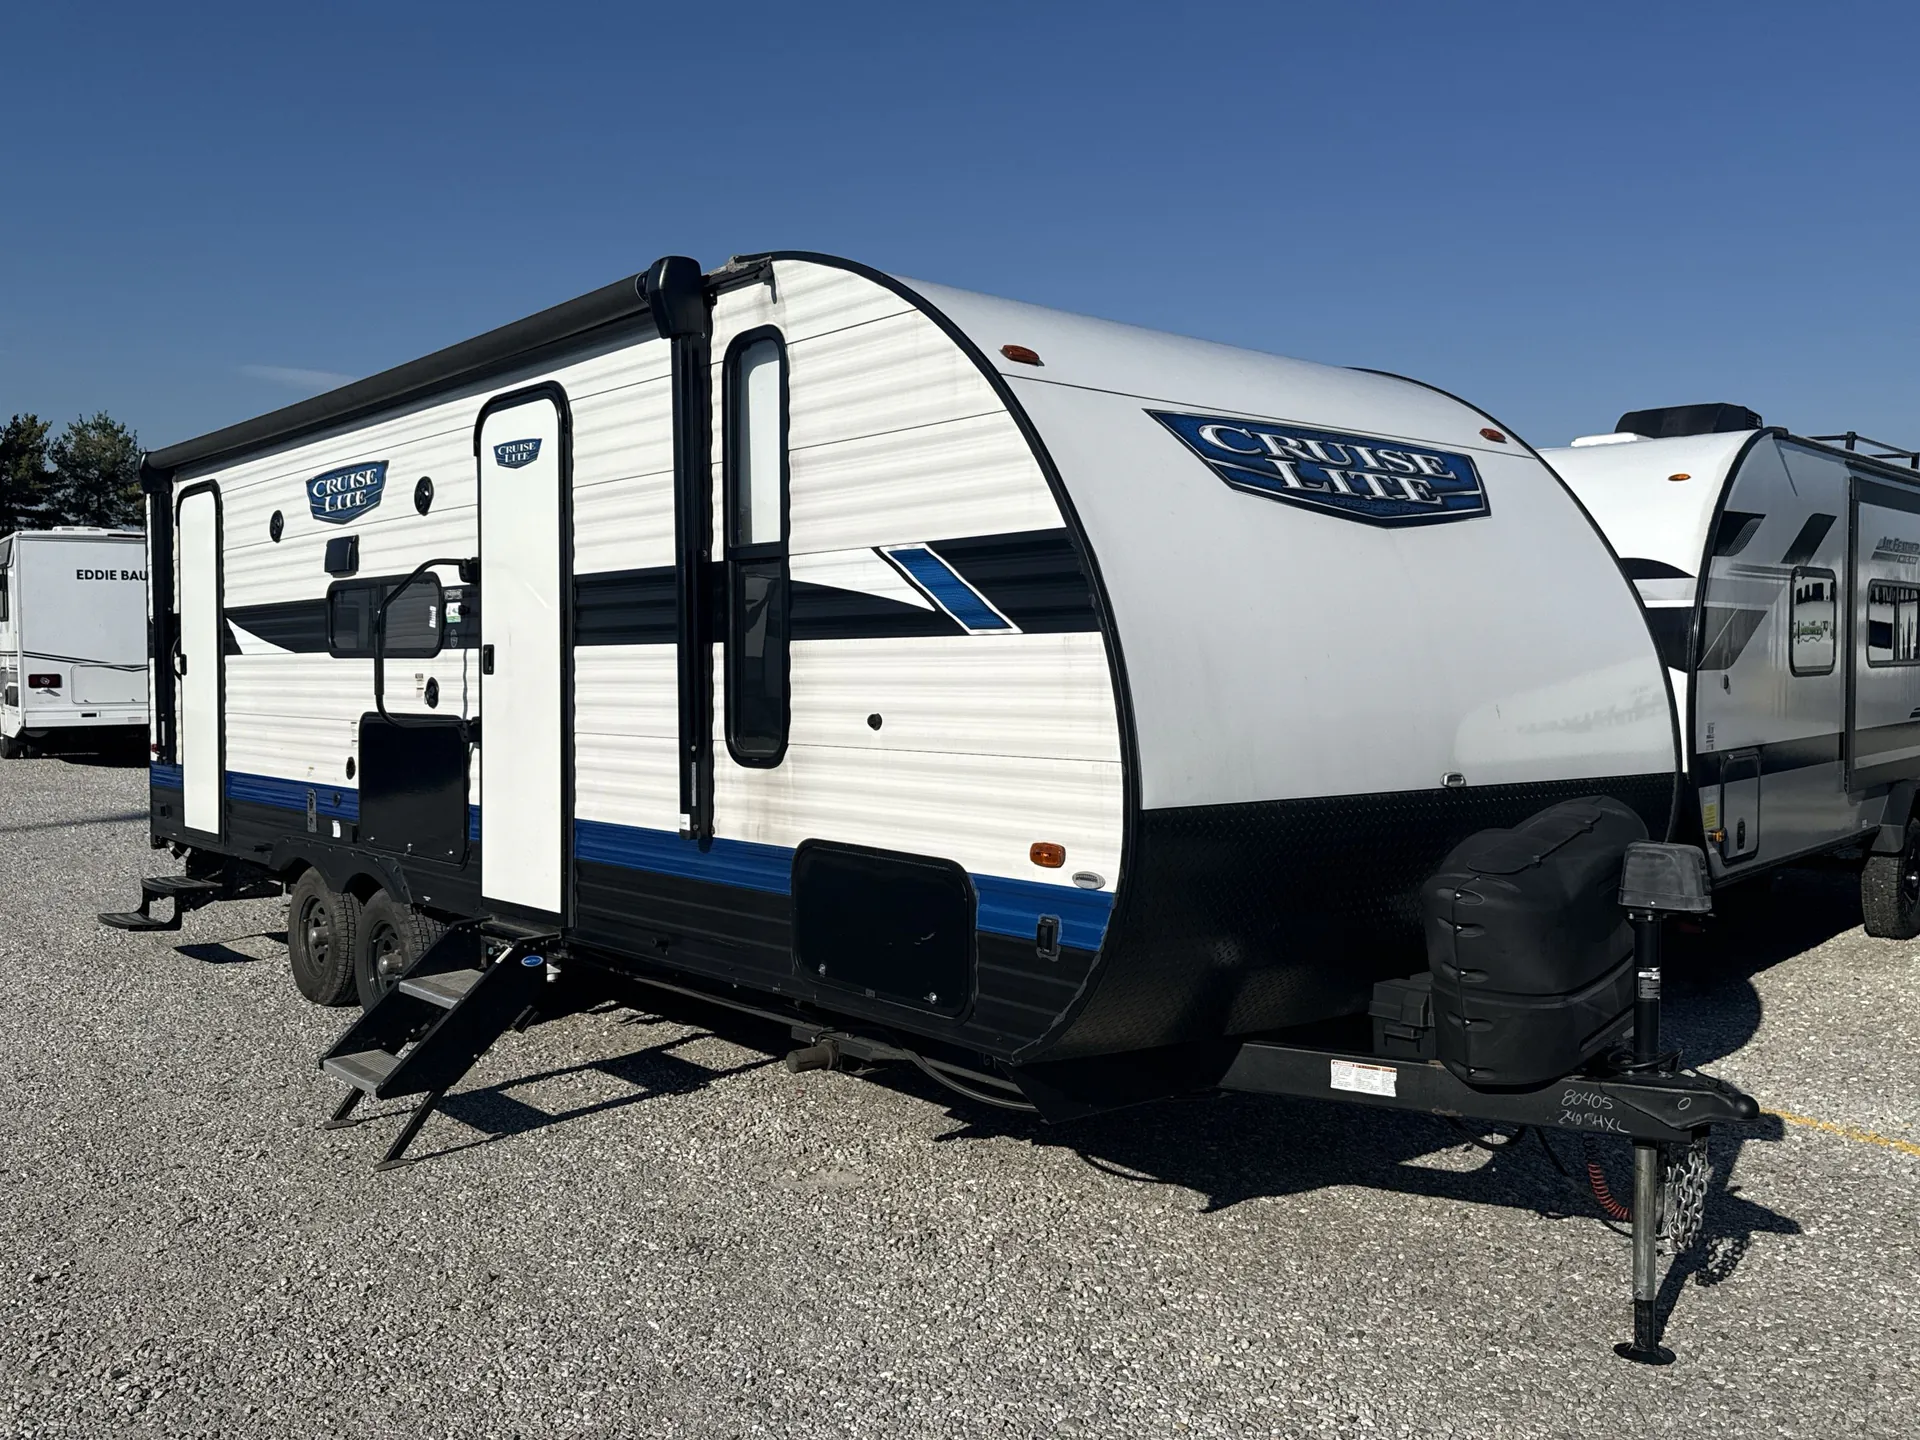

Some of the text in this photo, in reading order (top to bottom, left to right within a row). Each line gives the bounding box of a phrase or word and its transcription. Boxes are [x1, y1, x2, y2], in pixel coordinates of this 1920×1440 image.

[497, 441, 536, 455] CRUISE
[505, 451, 530, 463] LITE
[1198, 424, 1457, 480] CRUISE
[312, 468, 378, 498] CRUISE
[1264, 457, 1443, 505] LITE
[324, 489, 367, 513] LITE
[76, 569, 117, 581] EDDIE
[1561, 1089, 1613, 1110] 80405
